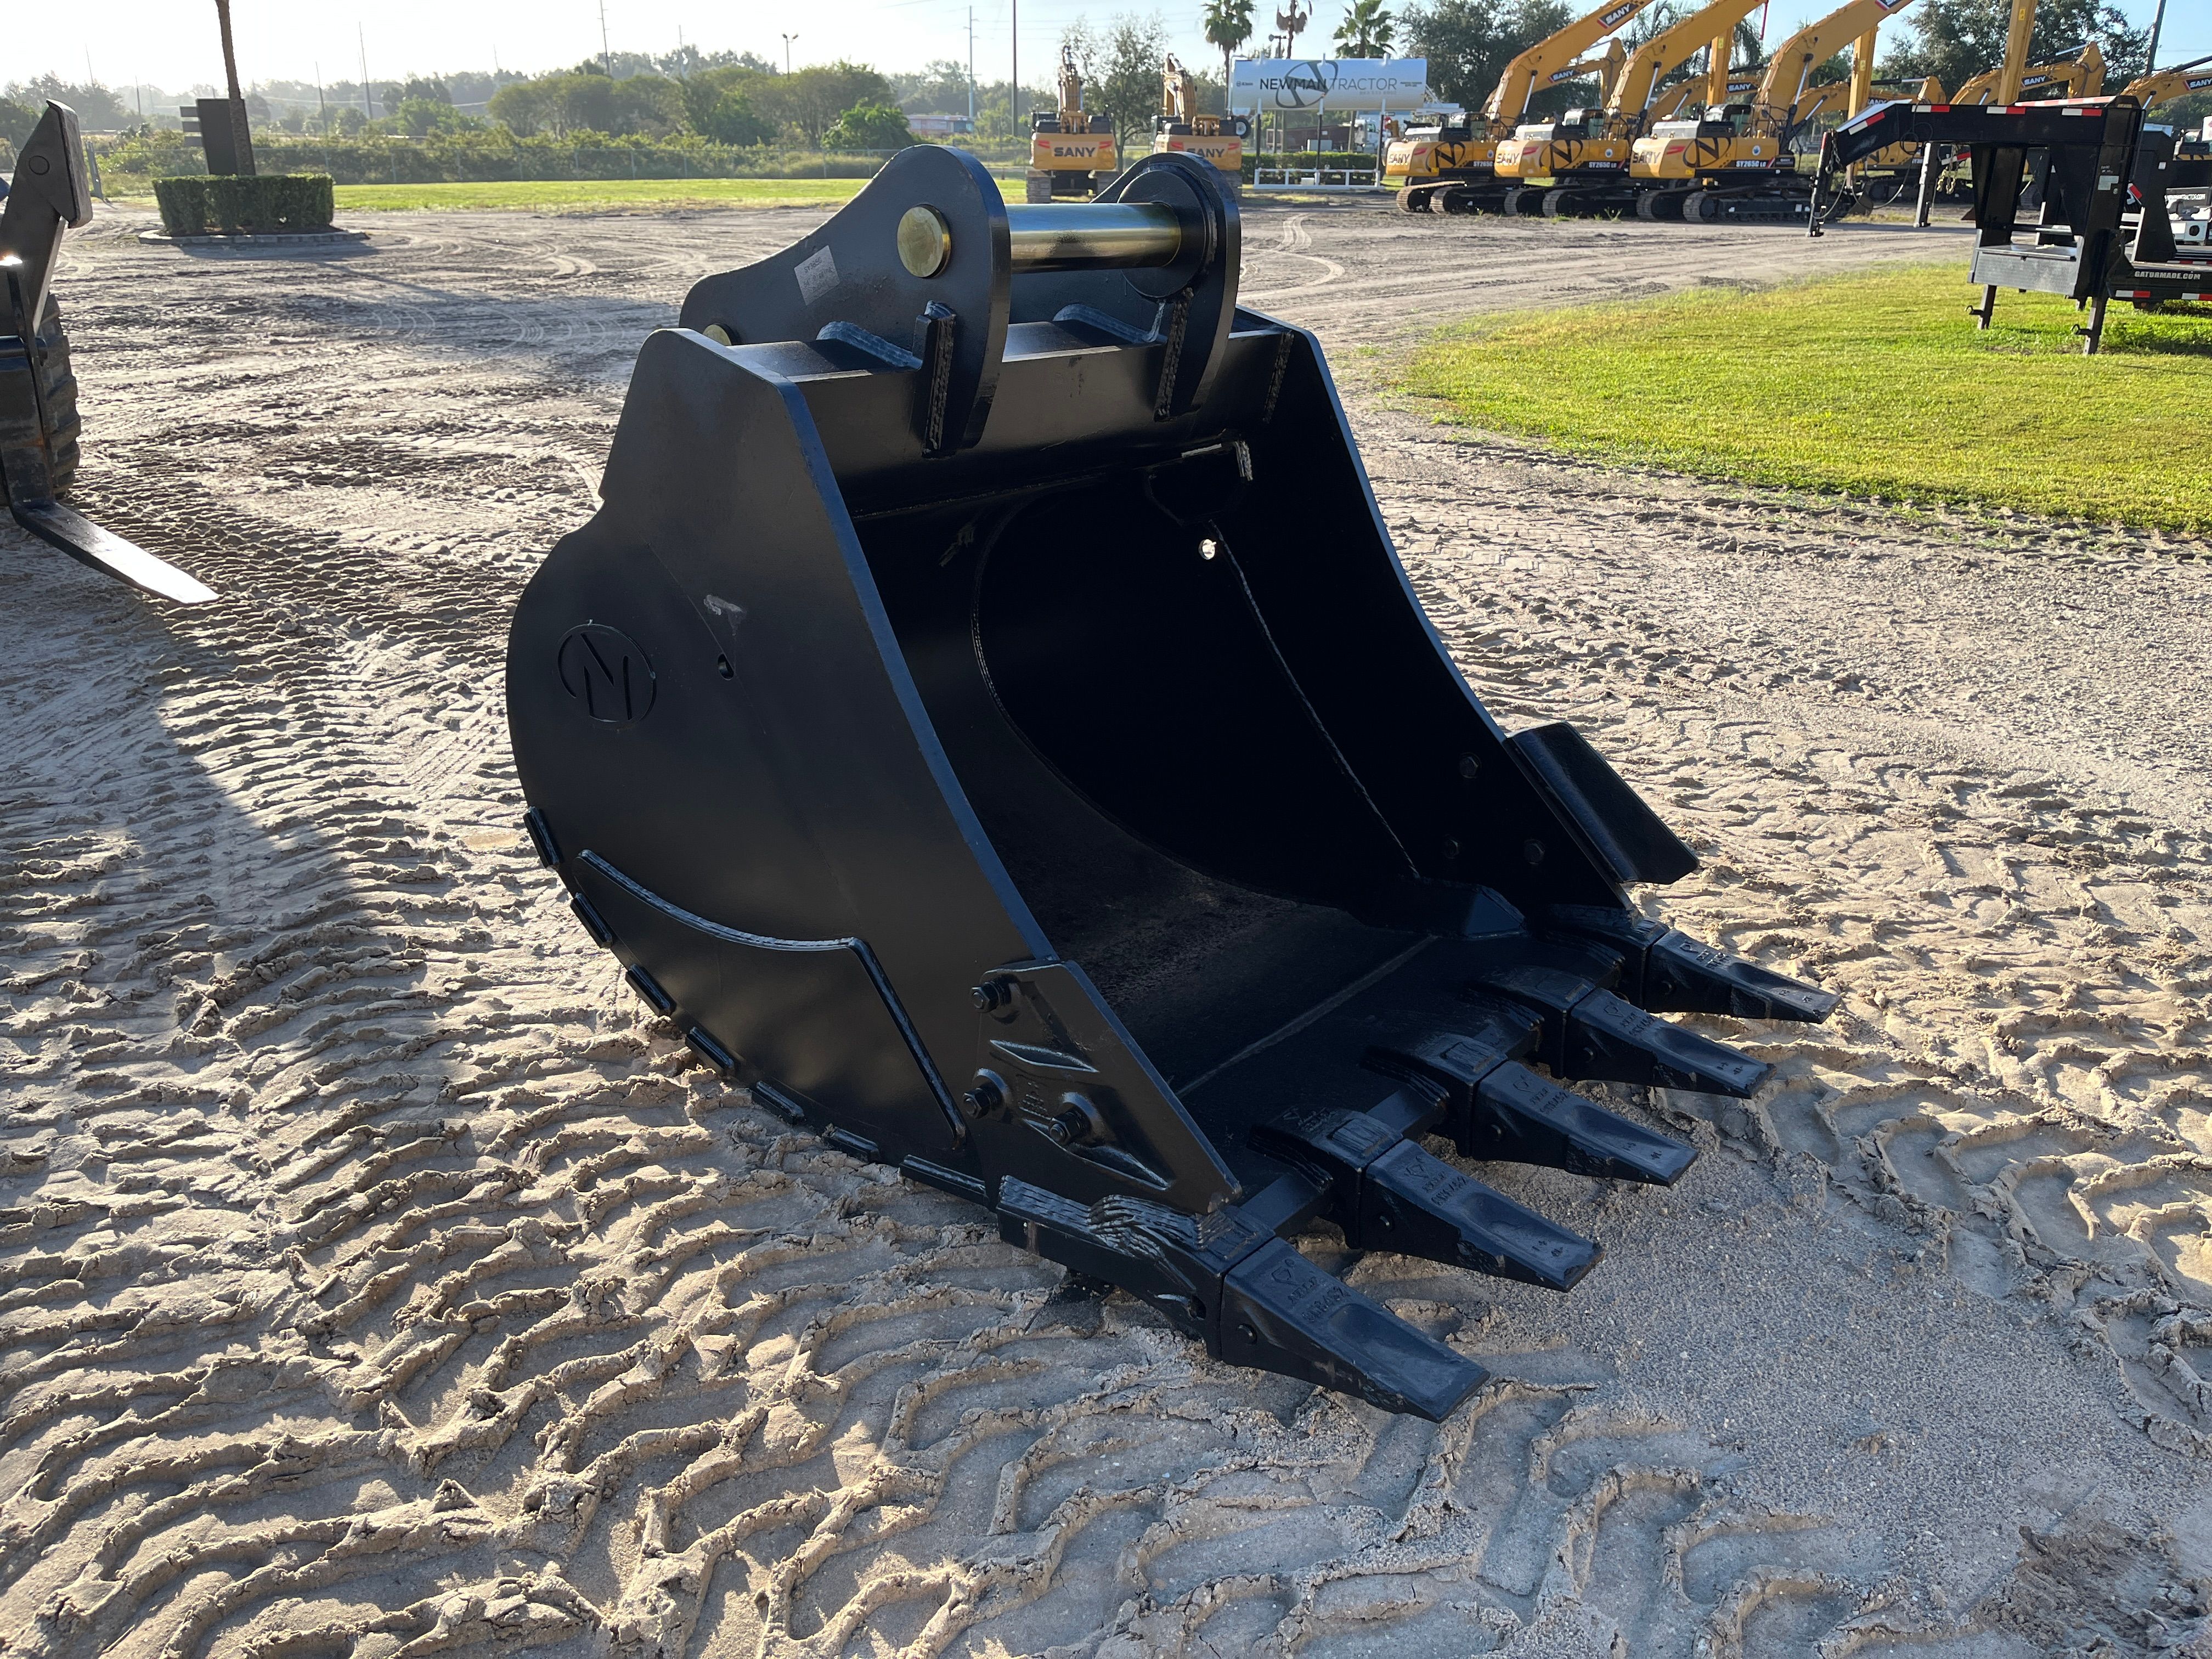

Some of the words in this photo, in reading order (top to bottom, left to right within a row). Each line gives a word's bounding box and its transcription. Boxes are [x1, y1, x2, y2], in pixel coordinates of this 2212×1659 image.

[1605, 4, 1630, 24] SANY
[1553, 70, 1573, 81] SANY
[2024, 76, 2046, 85] SANY
[1260, 78, 1327, 90] NEWMAN
[1330, 78, 1397, 90] TRACTOR
[1729, 83, 1751, 92] SANY
[2190, 78, 2212, 88] SANY
[1054, 146, 1096, 157] SANY
[1389, 154, 1410, 164] SANY
[1497, 153, 1519, 165] SANY
[1633, 151, 1661, 164] SANY
[2134, 271, 2201, 280] GATORMADE.COM
